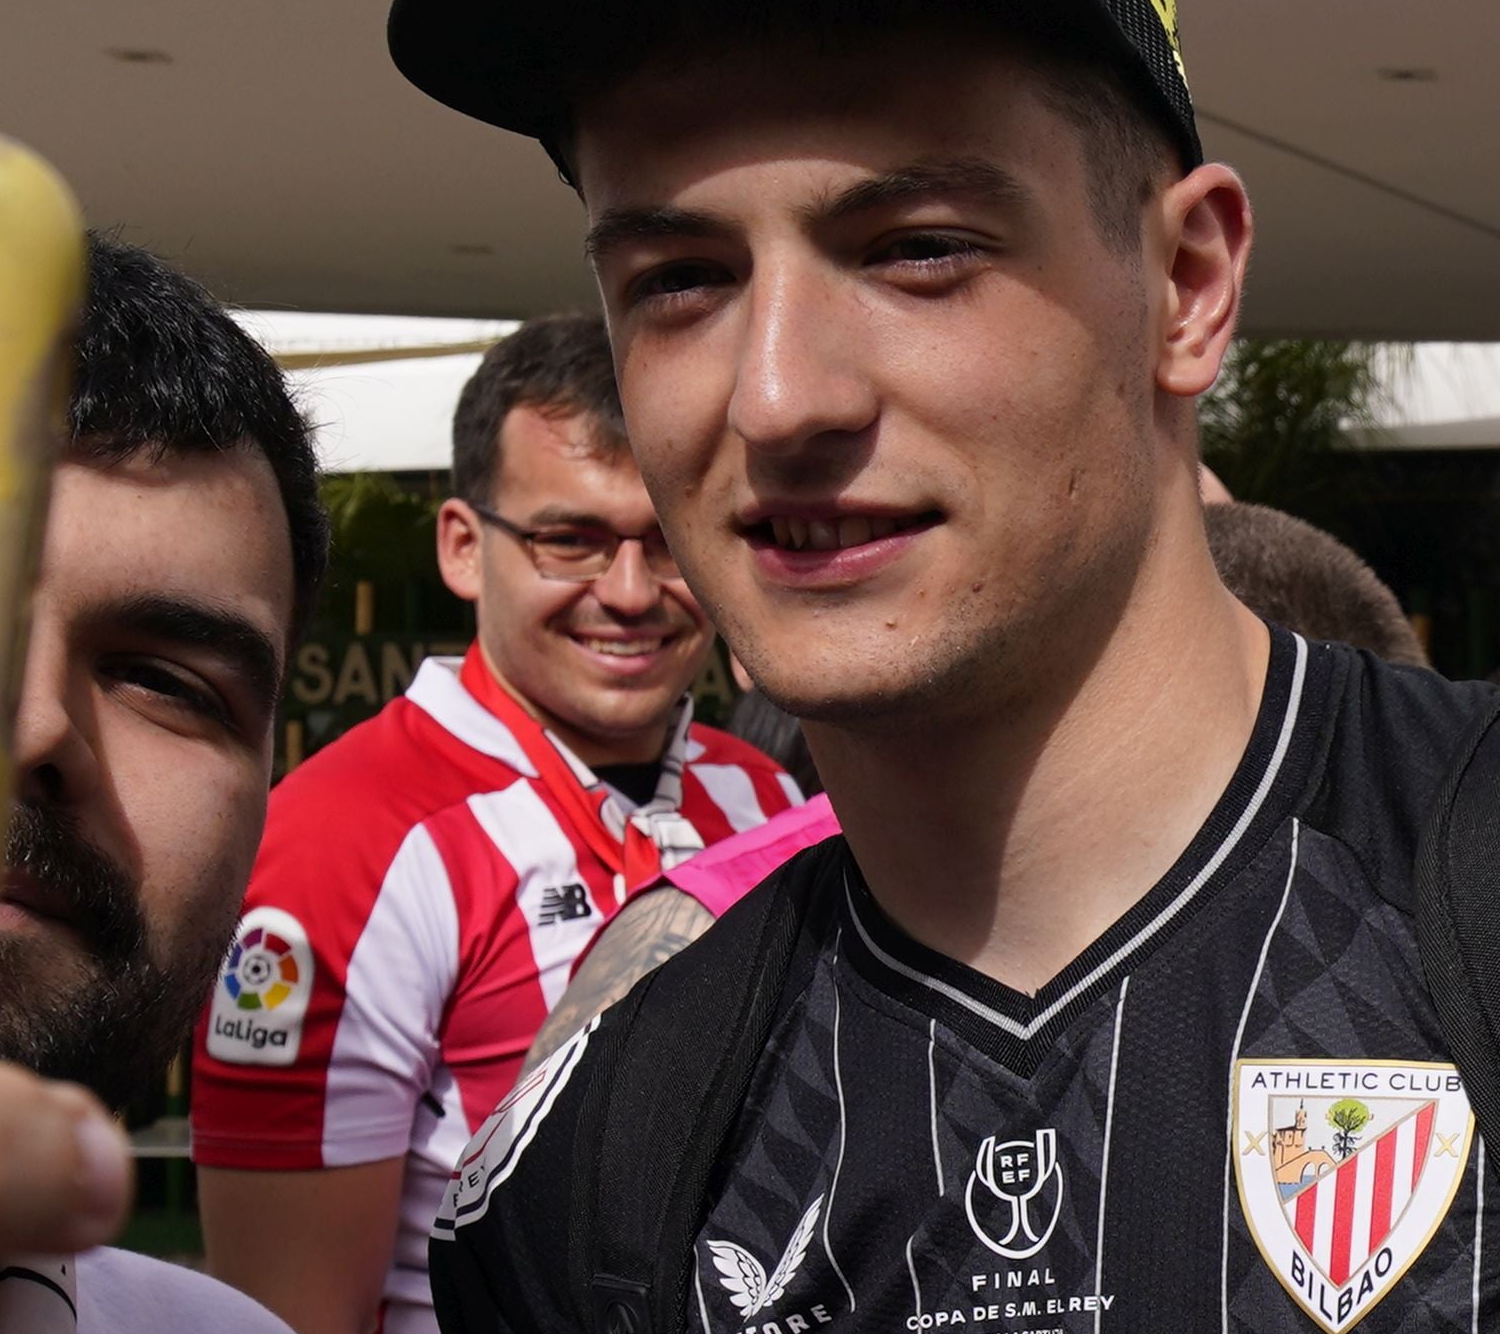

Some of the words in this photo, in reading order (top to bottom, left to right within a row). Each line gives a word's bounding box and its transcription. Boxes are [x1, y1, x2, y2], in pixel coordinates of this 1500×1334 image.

[214, 1015, 289, 1049] LaLiga
[1251, 1071, 1379, 1091] ATHLETIC
[1388, 1073, 1461, 1092] CLUB
[971, 1268, 1056, 1292] FINAL
[1290, 1246, 1393, 1324] BILBAO
[906, 1309, 966, 1331] COPA
[973, 1304, 1000, 1322] DE
[1005, 1300, 1042, 1318] S.M.
[1046, 1299, 1065, 1314] EL
[1068, 1295, 1115, 1312] REY
